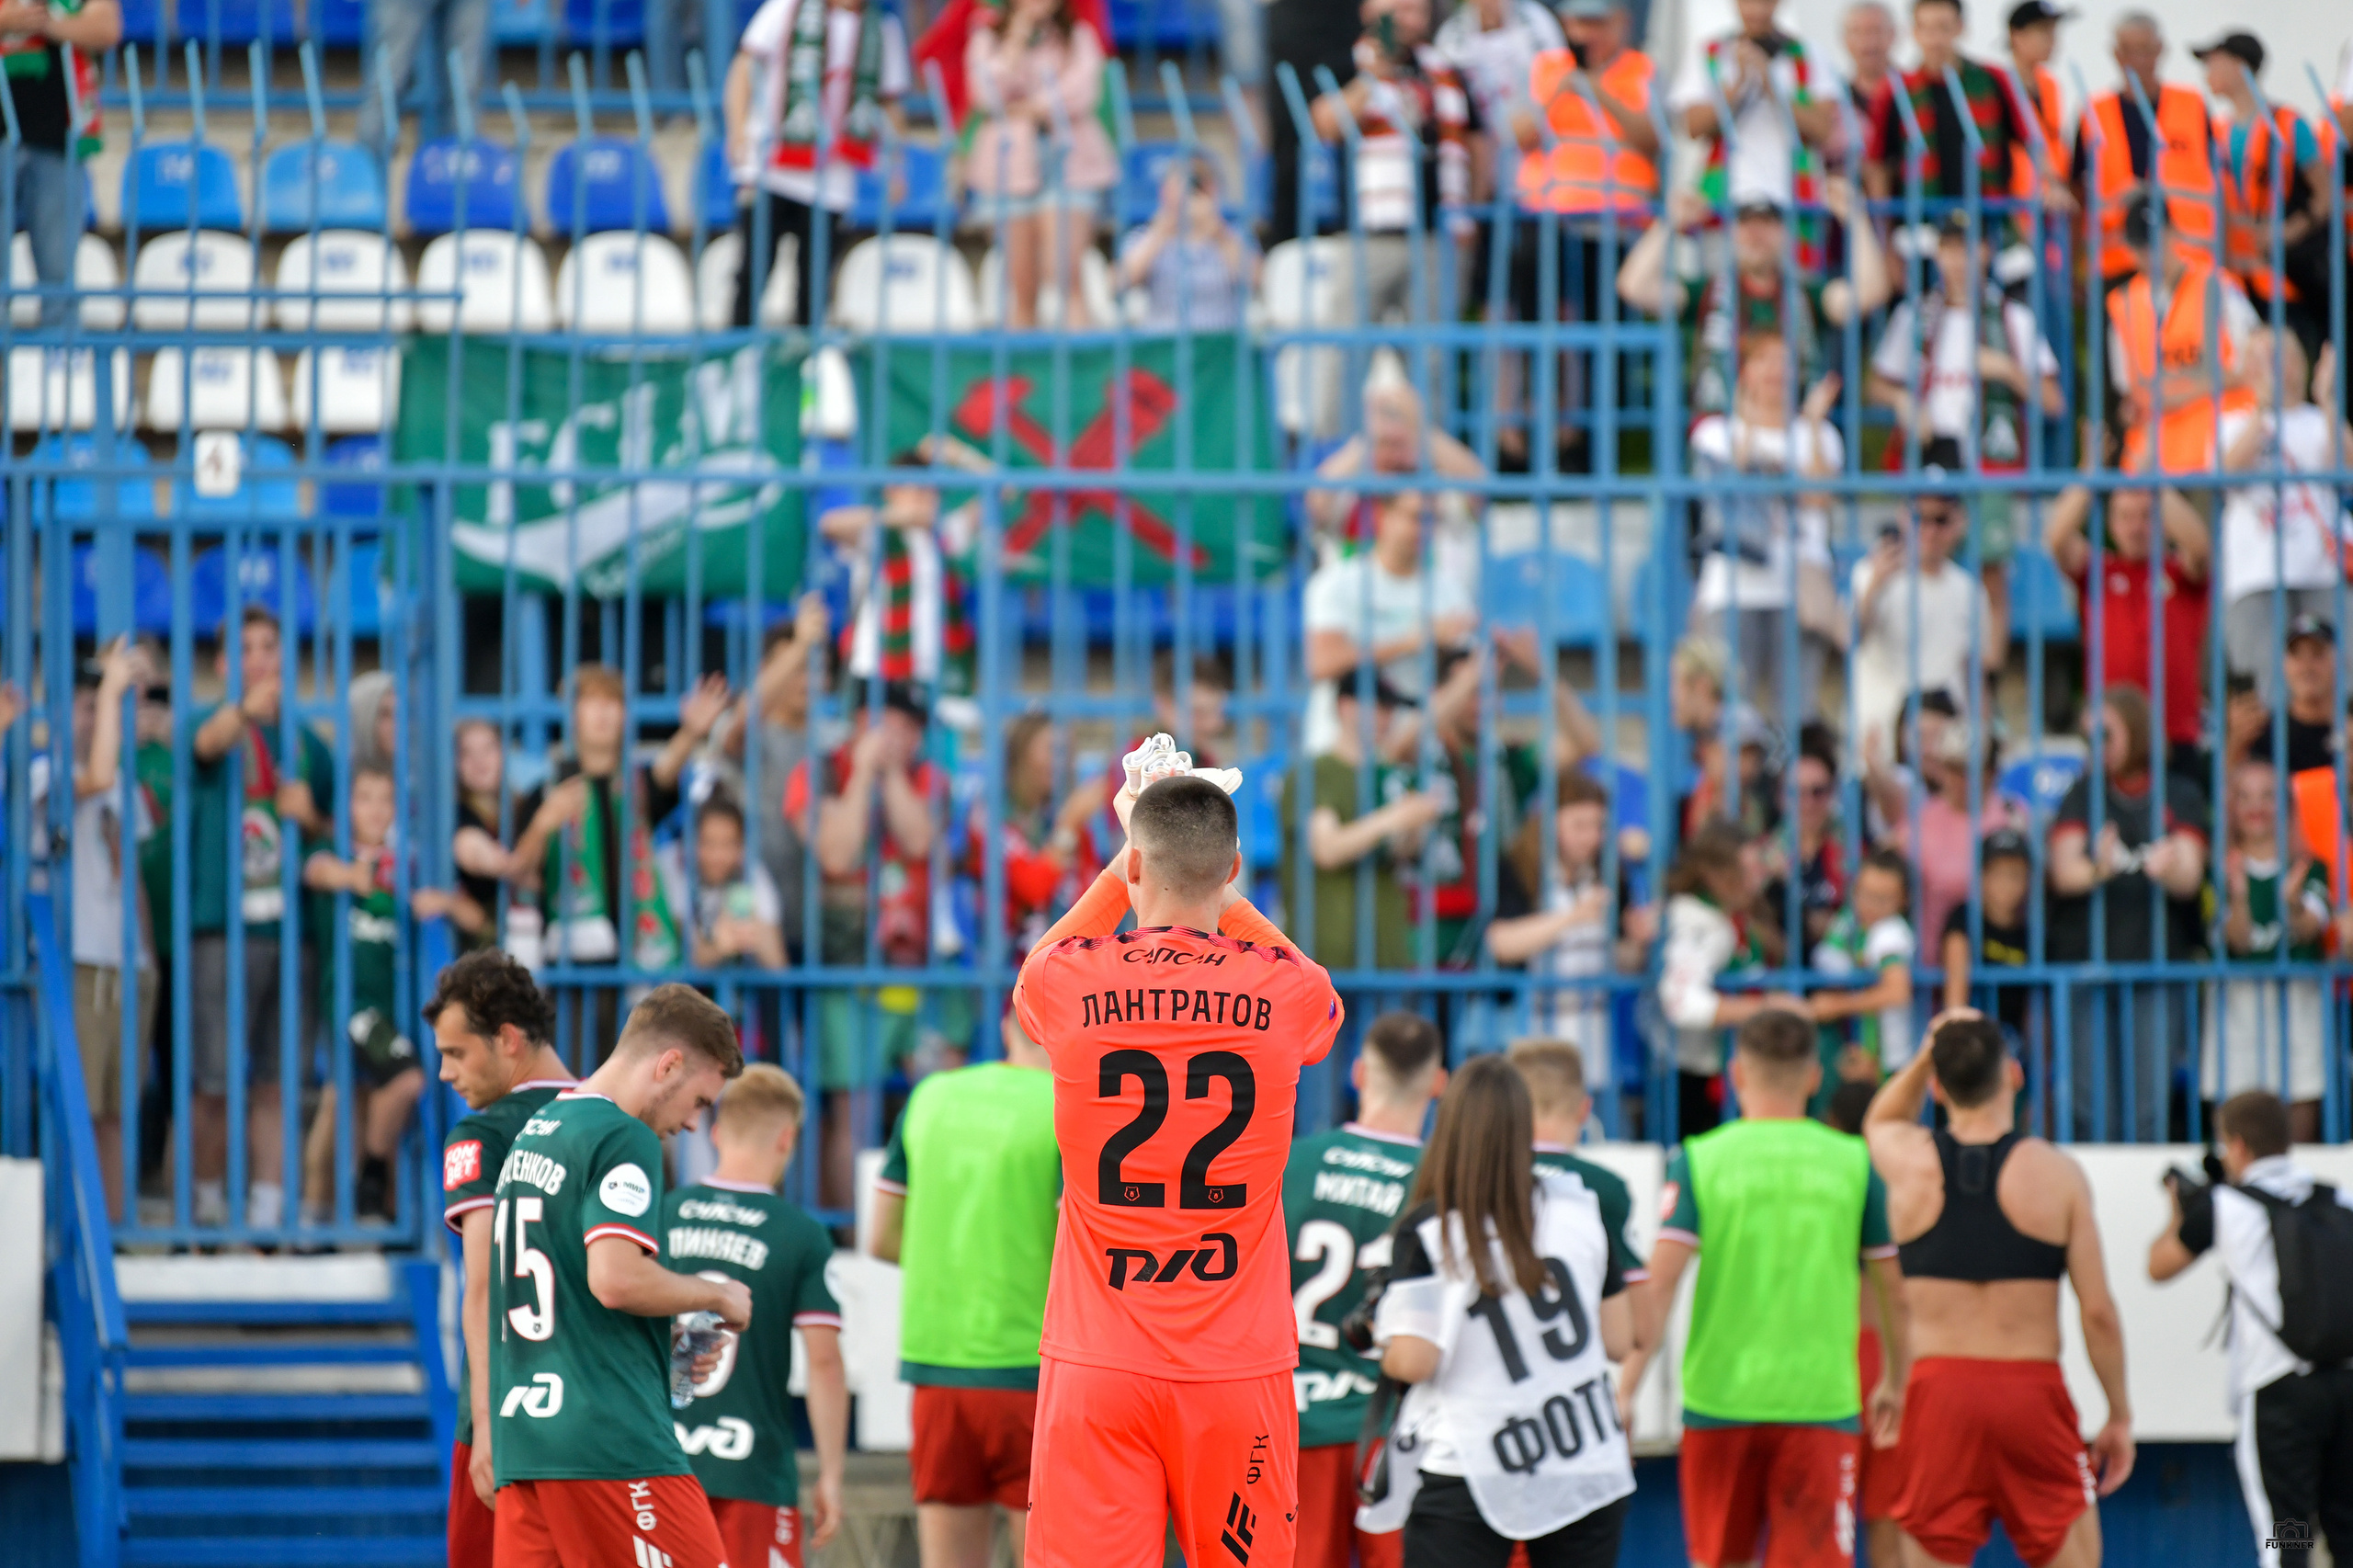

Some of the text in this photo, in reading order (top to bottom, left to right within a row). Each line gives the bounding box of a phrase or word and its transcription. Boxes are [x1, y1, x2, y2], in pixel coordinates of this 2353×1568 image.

[1081, 988, 1273, 1031] ЛАНТРАТОВ
[1098, 1049, 1256, 1210] 22
[445, 1142, 479, 1169] FON
[446, 1158, 478, 1187] BET
[494, 1197, 555, 1343] 15
[668, 1226, 770, 1271] ПИНЯЕВ
[1468, 1257, 1590, 1383] 19
[1245, 1434, 1269, 1485] ФГК
[628, 1481, 658, 1531] ФГК
